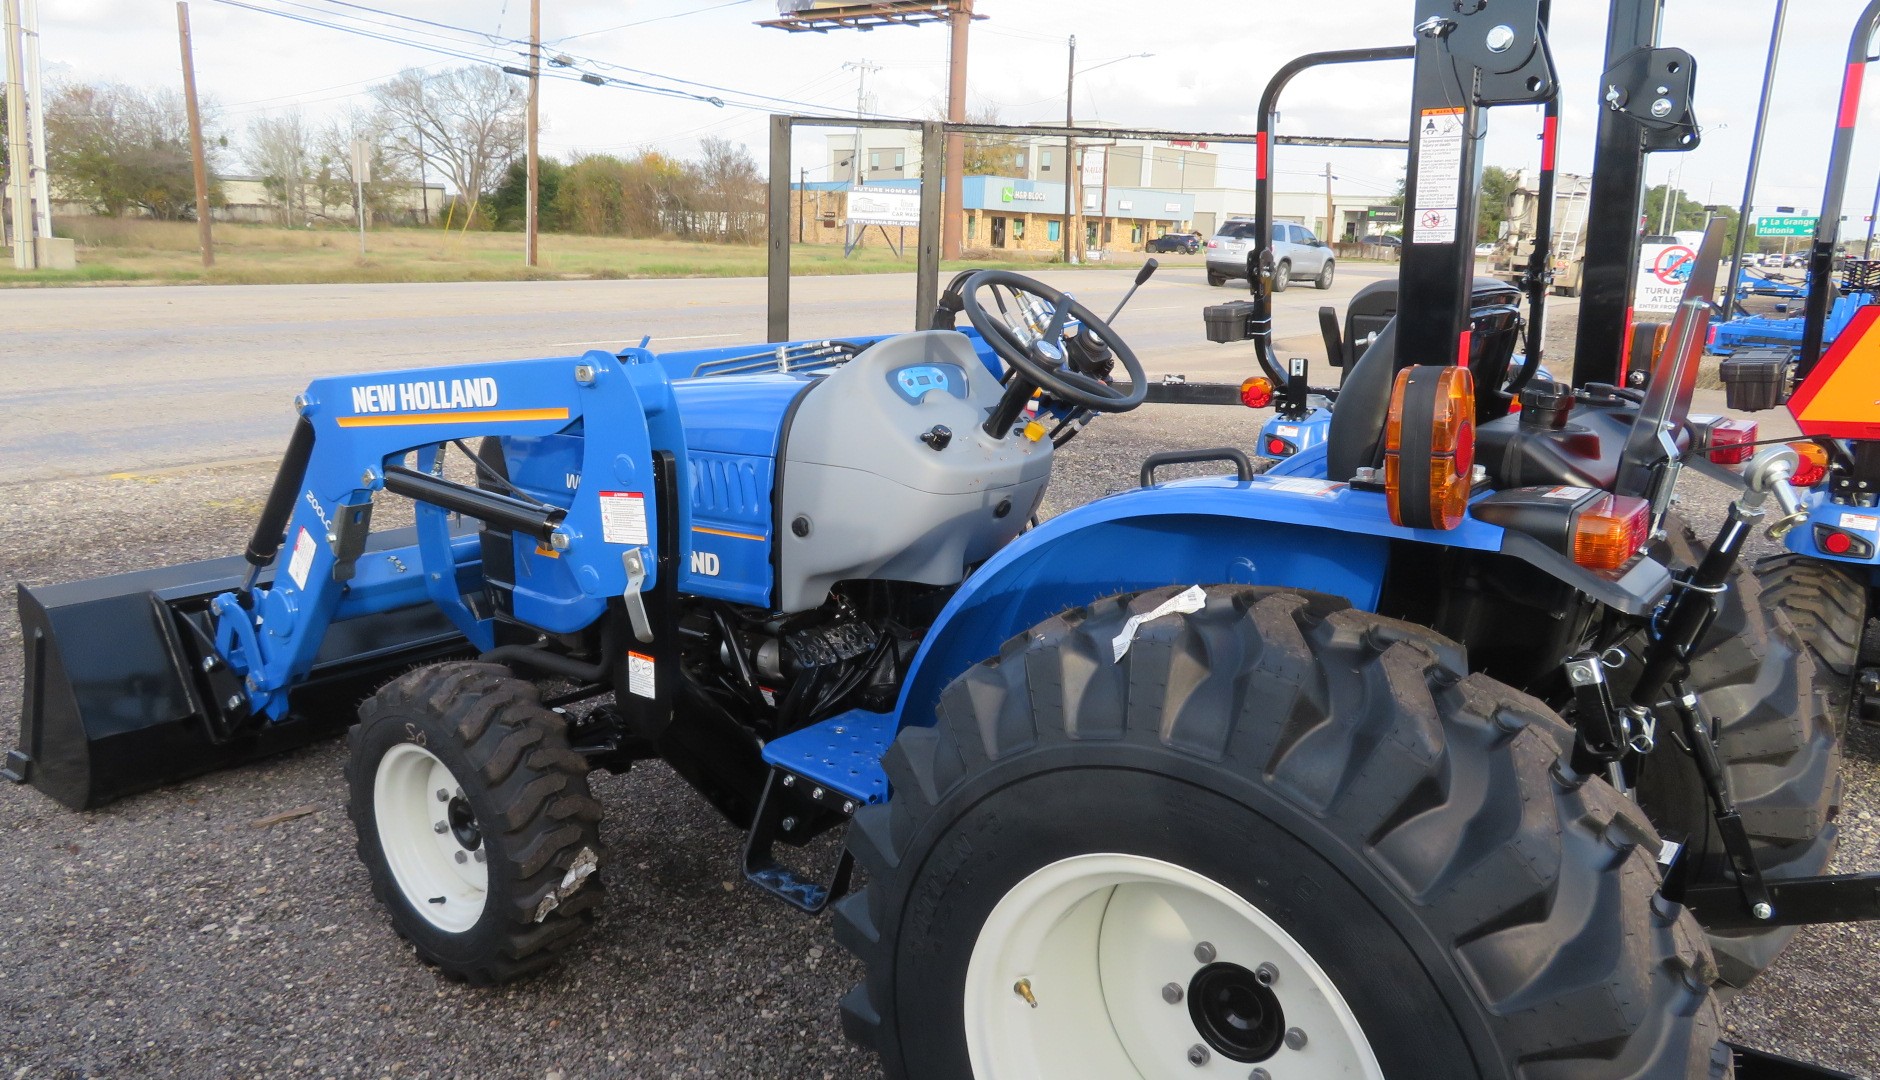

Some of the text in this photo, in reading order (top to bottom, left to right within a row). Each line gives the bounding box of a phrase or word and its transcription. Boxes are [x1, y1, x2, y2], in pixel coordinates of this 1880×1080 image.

[1770, 218, 1815, 227] La Grange
[1759, 226, 1795, 234] Flatonia
[1645, 287, 1670, 295] TURN
[351, 377, 498, 414] NEW HOLLAND
[566, 472, 581, 490] W
[691, 550, 720, 577] ND
